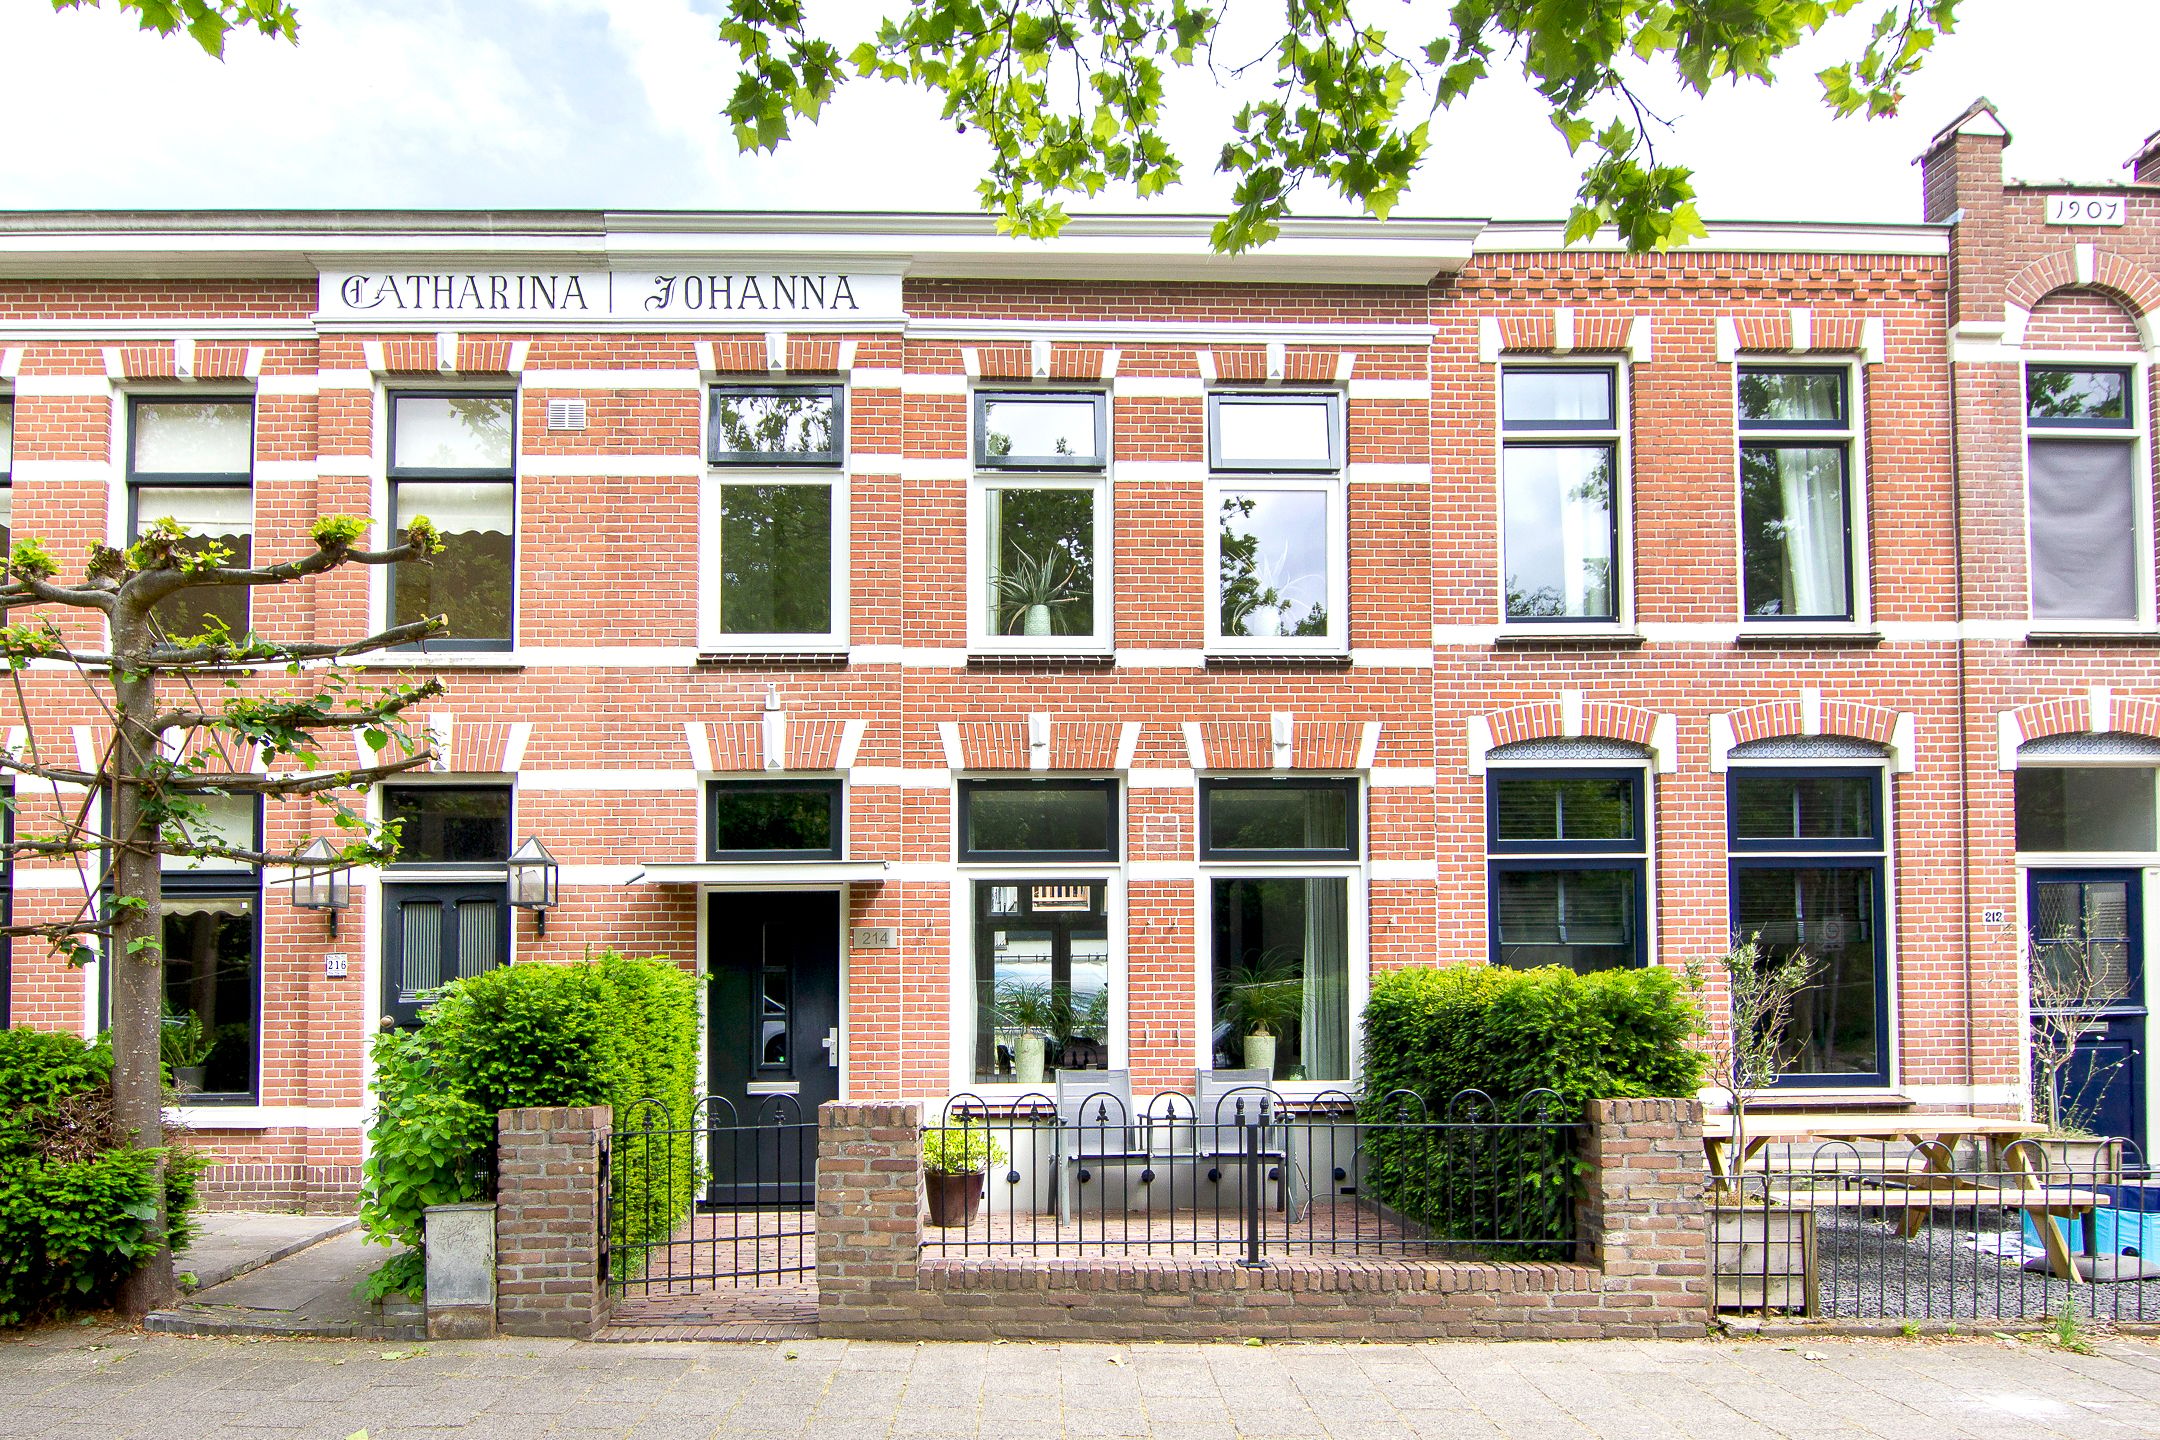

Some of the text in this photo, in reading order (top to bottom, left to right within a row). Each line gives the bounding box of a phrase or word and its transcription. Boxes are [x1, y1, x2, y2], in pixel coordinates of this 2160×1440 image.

[2056, 201, 2118, 220] 1907
[341, 274, 860, 312] CATHARINA JOHANNA
[1985, 911, 2003, 922] 212
[862, 932, 888, 944] 214
[328, 960, 346, 970] 216
